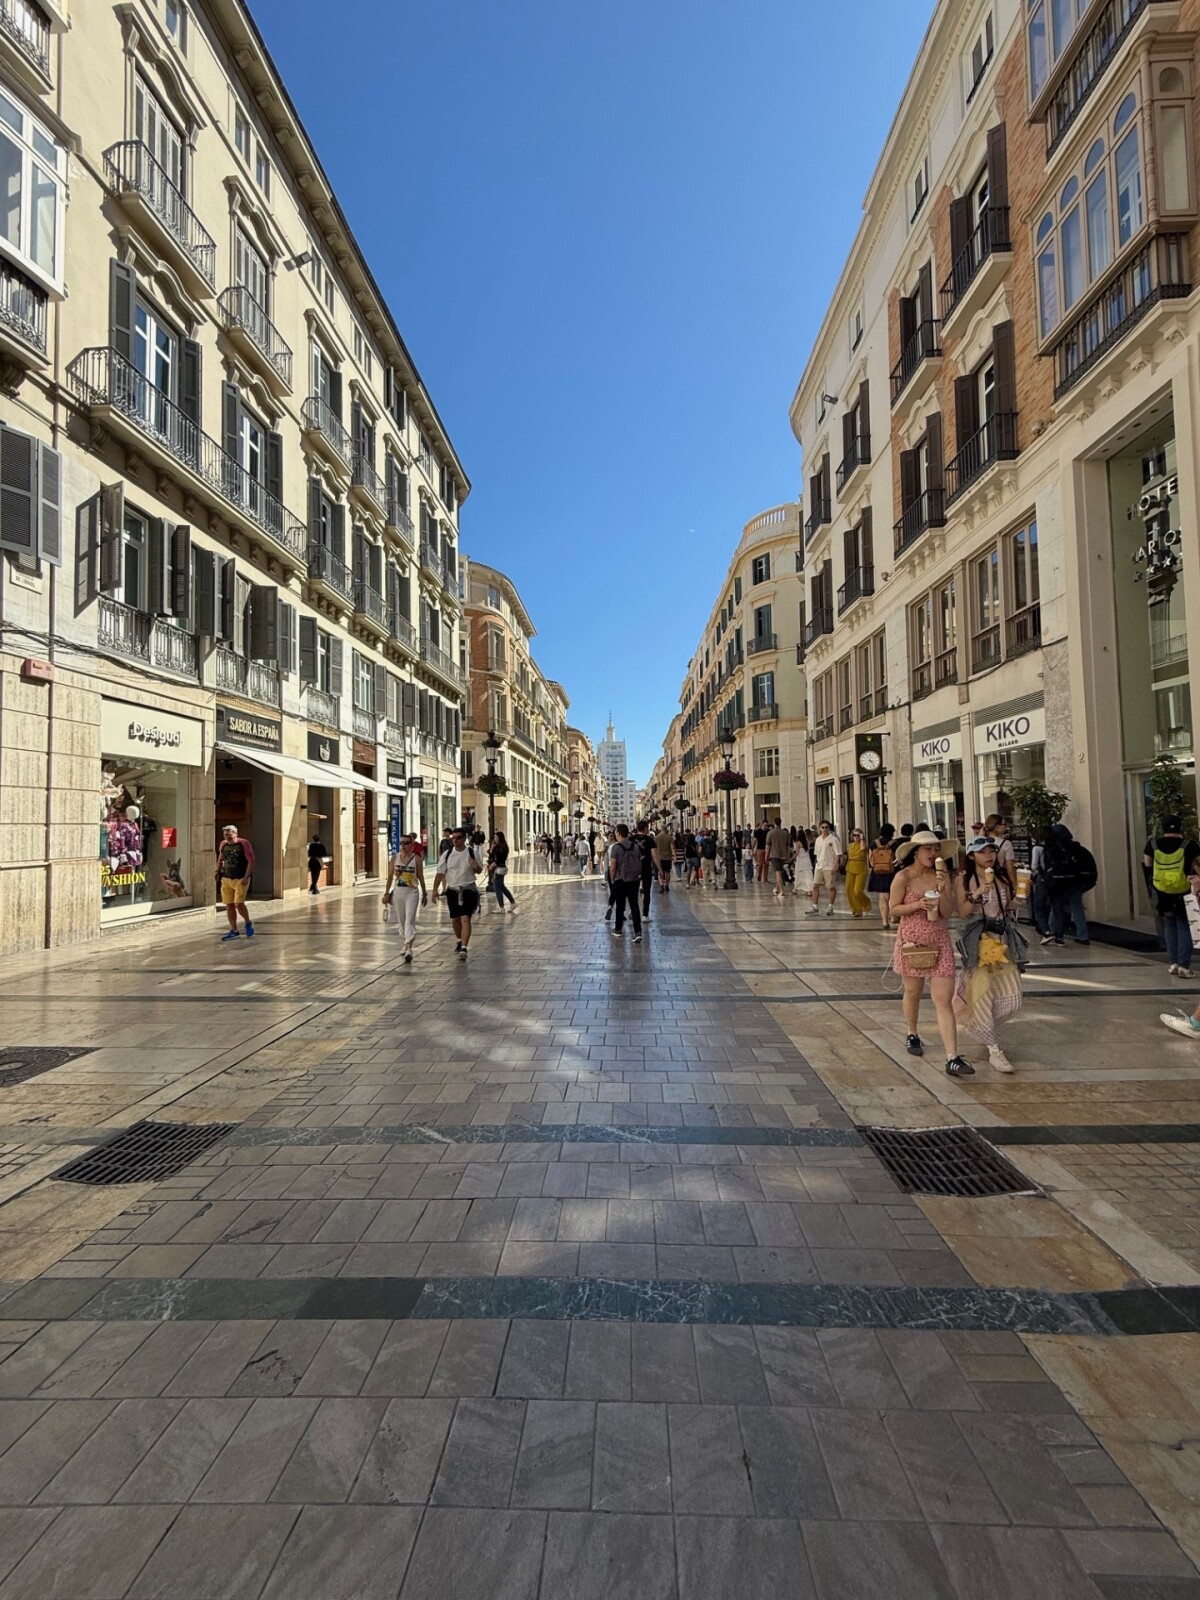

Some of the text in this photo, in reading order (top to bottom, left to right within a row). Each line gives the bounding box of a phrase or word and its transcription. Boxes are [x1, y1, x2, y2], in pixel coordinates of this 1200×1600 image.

[229, 716, 252, 735] SABOR
[986, 716, 1030, 743] KIKO
[921, 738, 950, 757] KIKO
[998, 739, 1019, 748] MILANO
